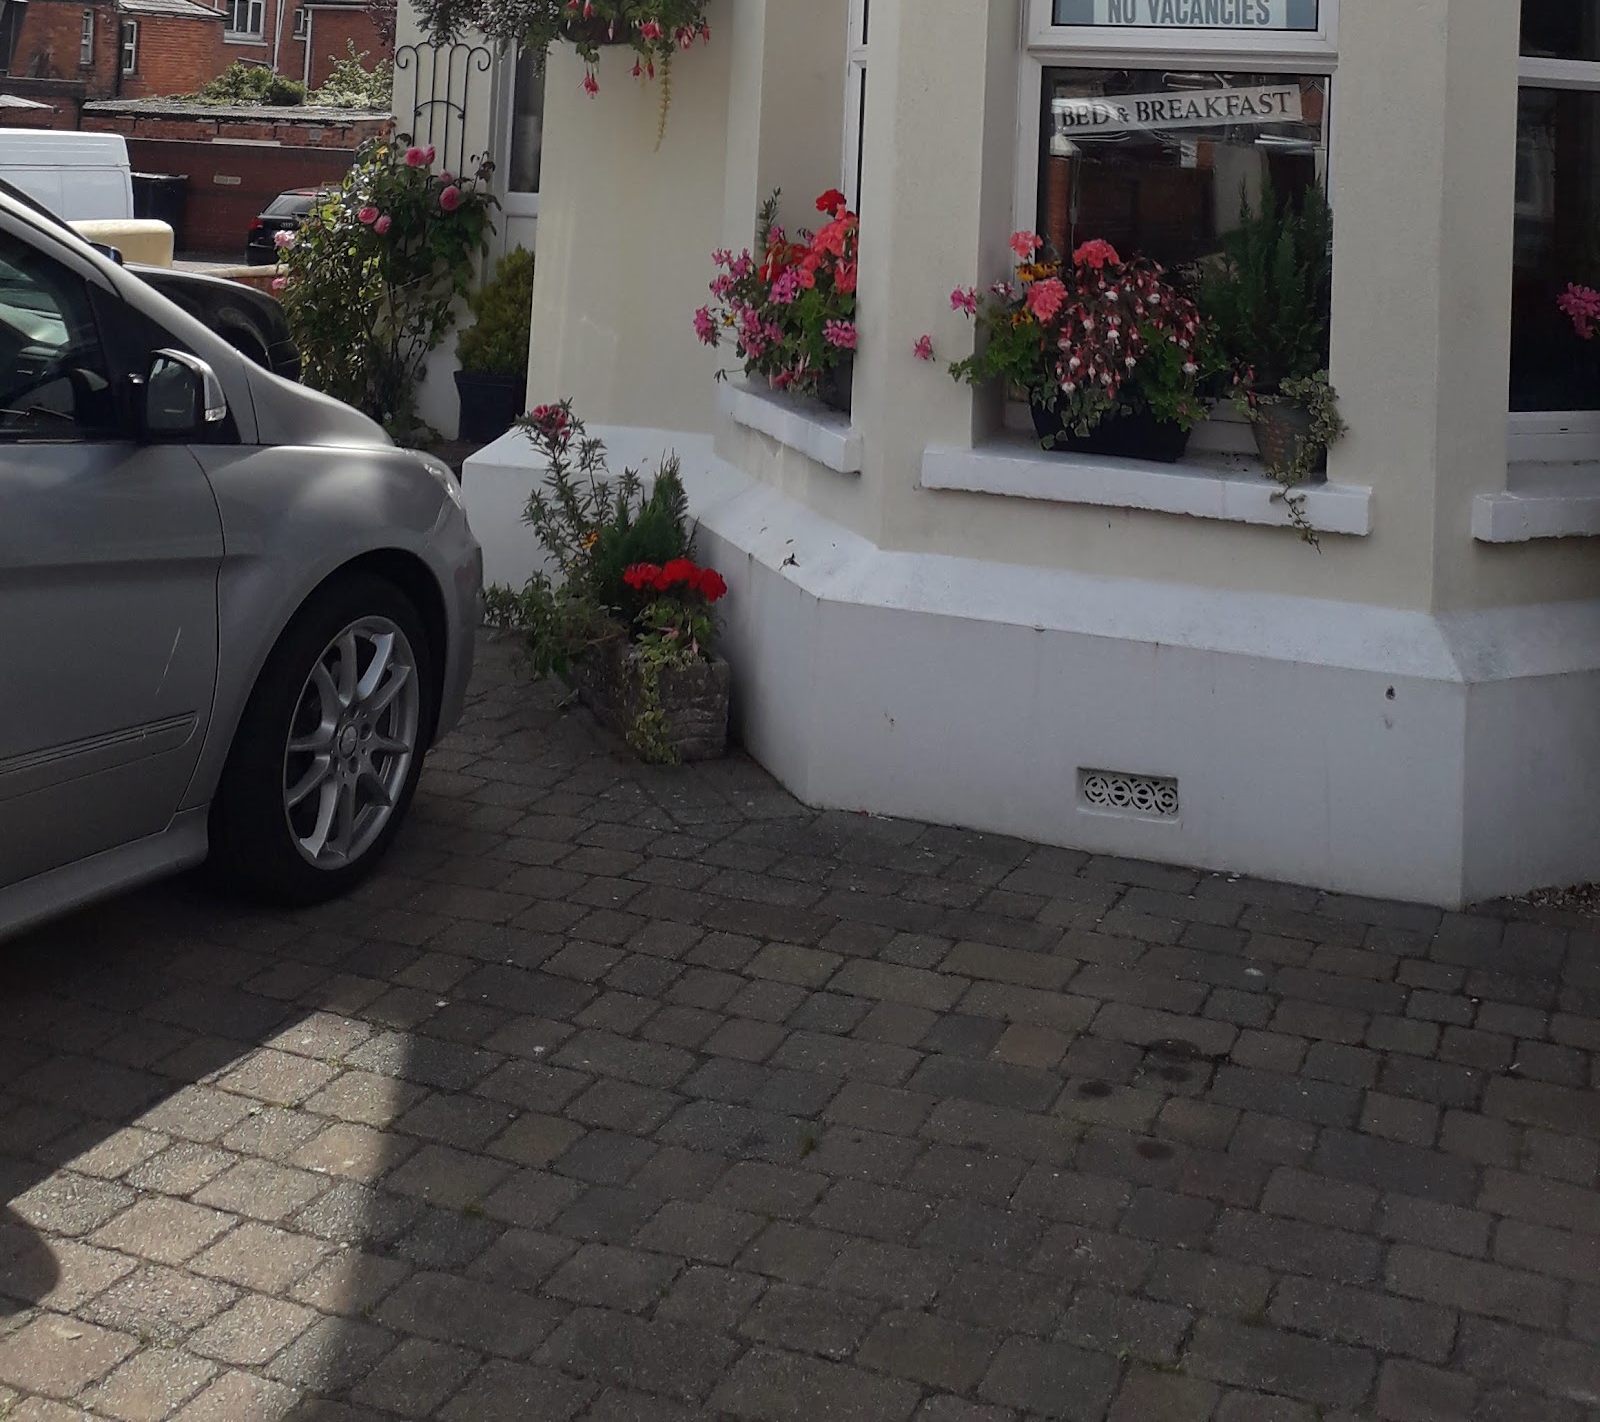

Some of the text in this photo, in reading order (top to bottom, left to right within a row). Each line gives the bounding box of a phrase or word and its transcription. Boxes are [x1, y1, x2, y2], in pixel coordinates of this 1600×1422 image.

[1062, 91, 1291, 127] BED & BREAKFAST
